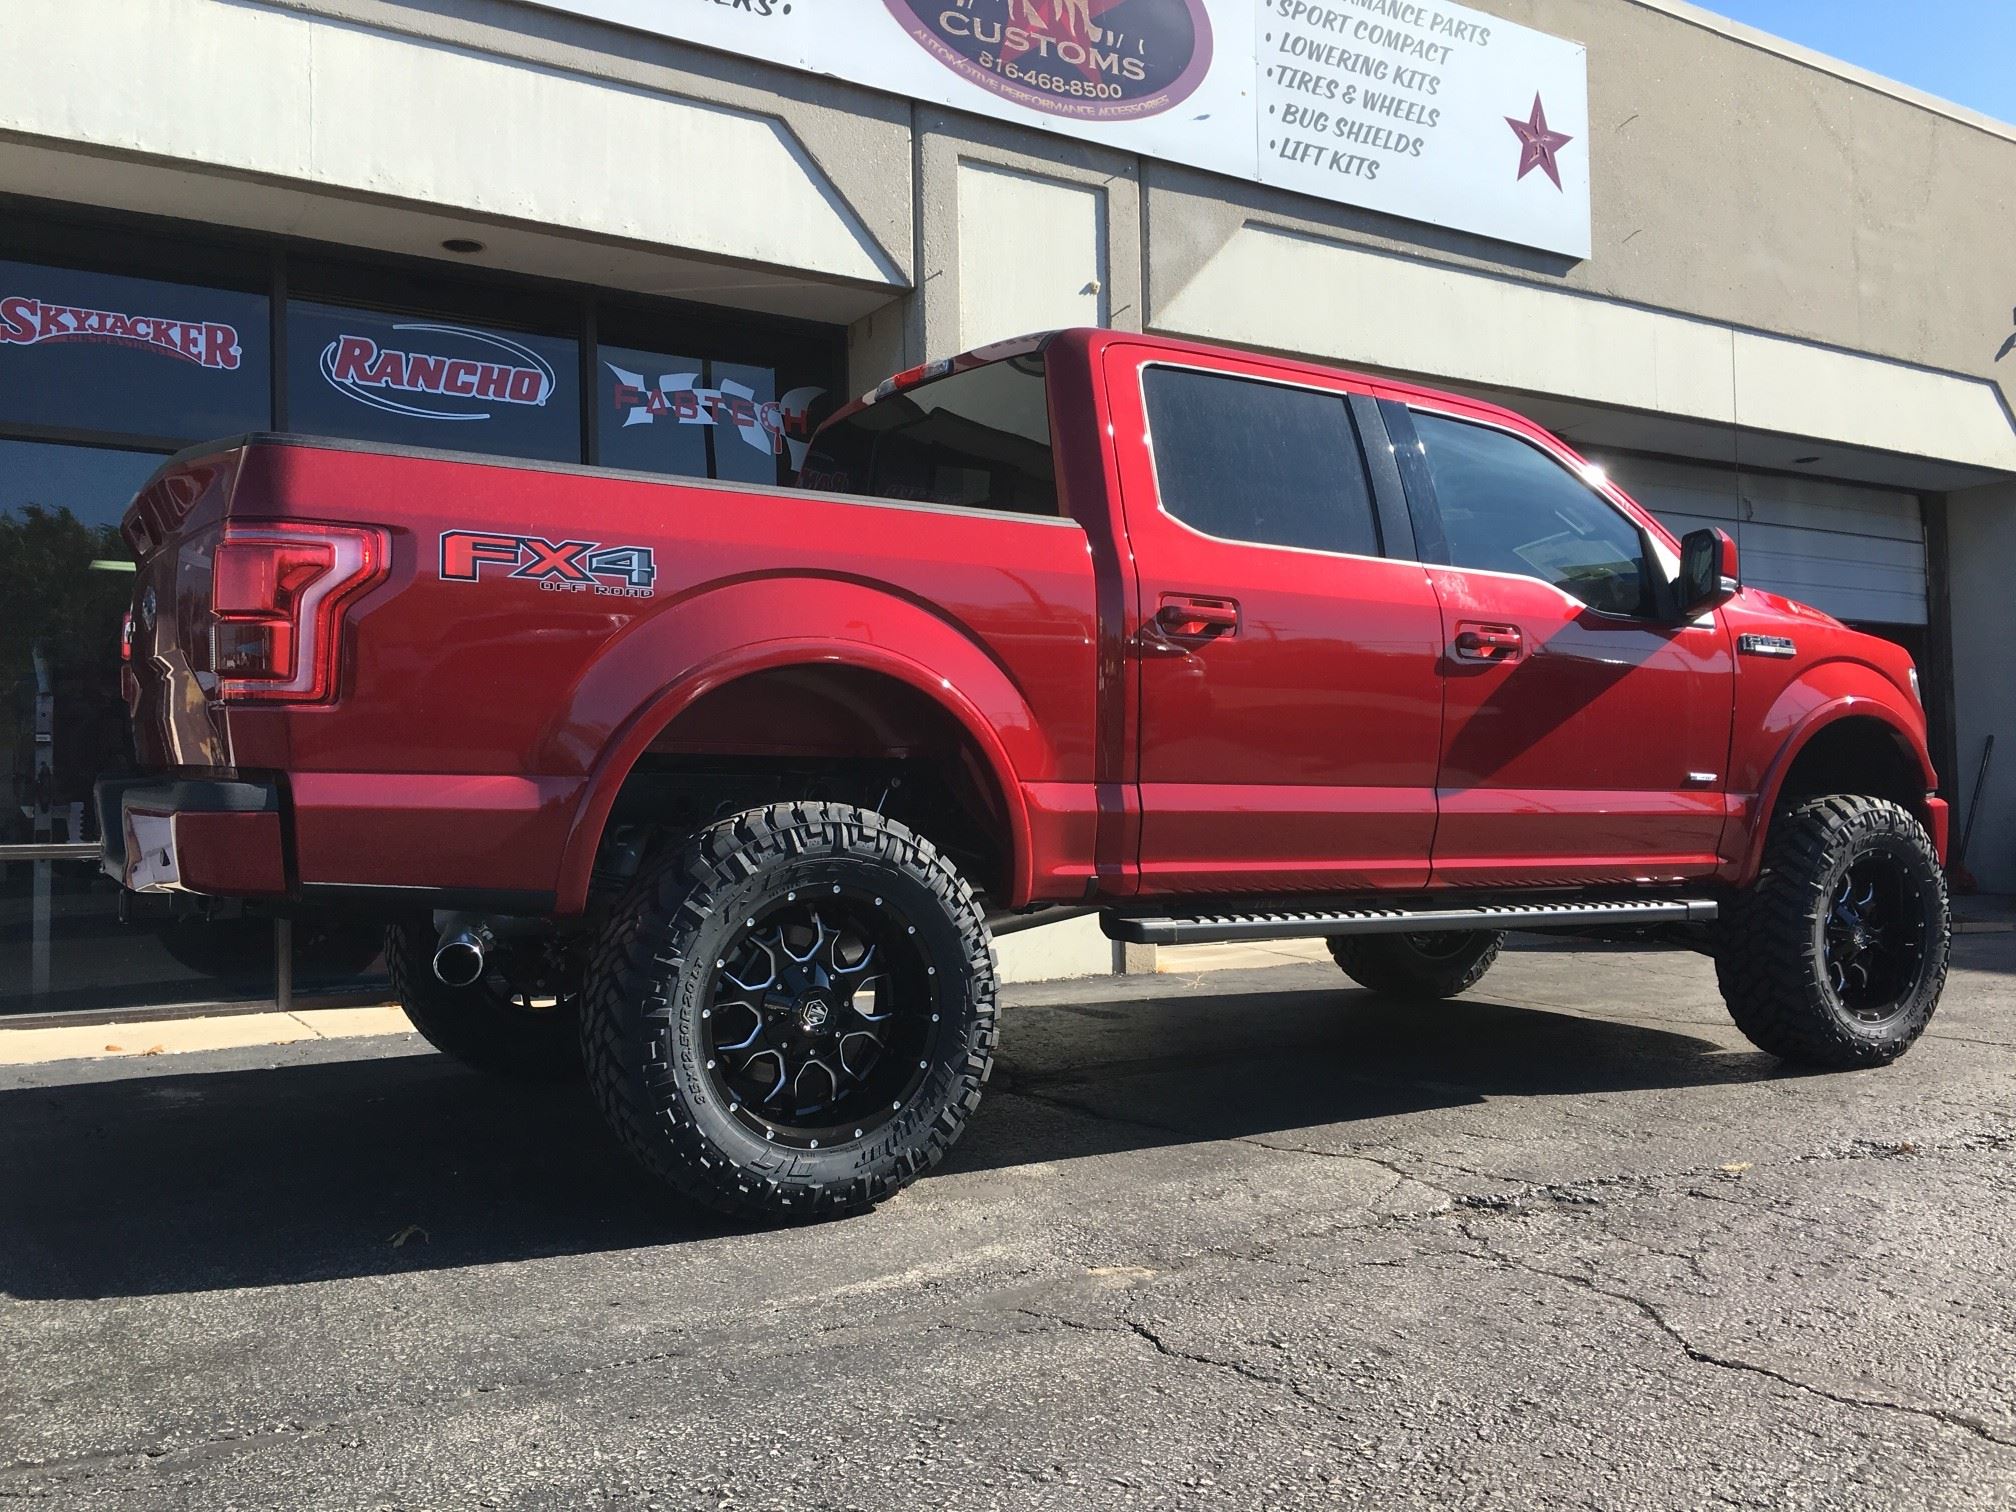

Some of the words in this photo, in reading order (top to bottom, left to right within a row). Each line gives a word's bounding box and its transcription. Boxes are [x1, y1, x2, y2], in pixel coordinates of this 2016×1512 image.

[940, 10, 1146, 81] CUSTOMS
[1277, 0, 1353, 34] SPORT
[1353, 19, 1454, 66] COMPACT
[1430, 12, 1491, 47] PARTS
[913, 29, 999, 88] AUTOMOTIVE
[1001, 84, 1095, 117] PERFORMANCE
[1098, 94, 1169, 117] ACCESSORIES
[979, 50, 1122, 99] 816-468-8500
[1279, 31, 1389, 81] LOWERING
[1392, 64, 1441, 96] KITS
[1276, 64, 1340, 100] TIRES
[1342, 84, 1357, 105] &
[1362, 88, 1441, 128] WHEELS
[1279, 137, 1329, 166] LIFT
[1328, 150, 1381, 180] KITS
[1281, 102, 1330, 133] BUG
[1332, 116, 1425, 158] SHIELDS
[0, 297, 241, 370] SKYJACKER
[333, 335, 546, 406] RANCHO
[614, 383, 808, 454] FABTECH
[439, 529, 656, 588] FX4
[539, 580, 587, 593] OFF
[594, 584, 655, 599] ROAD
